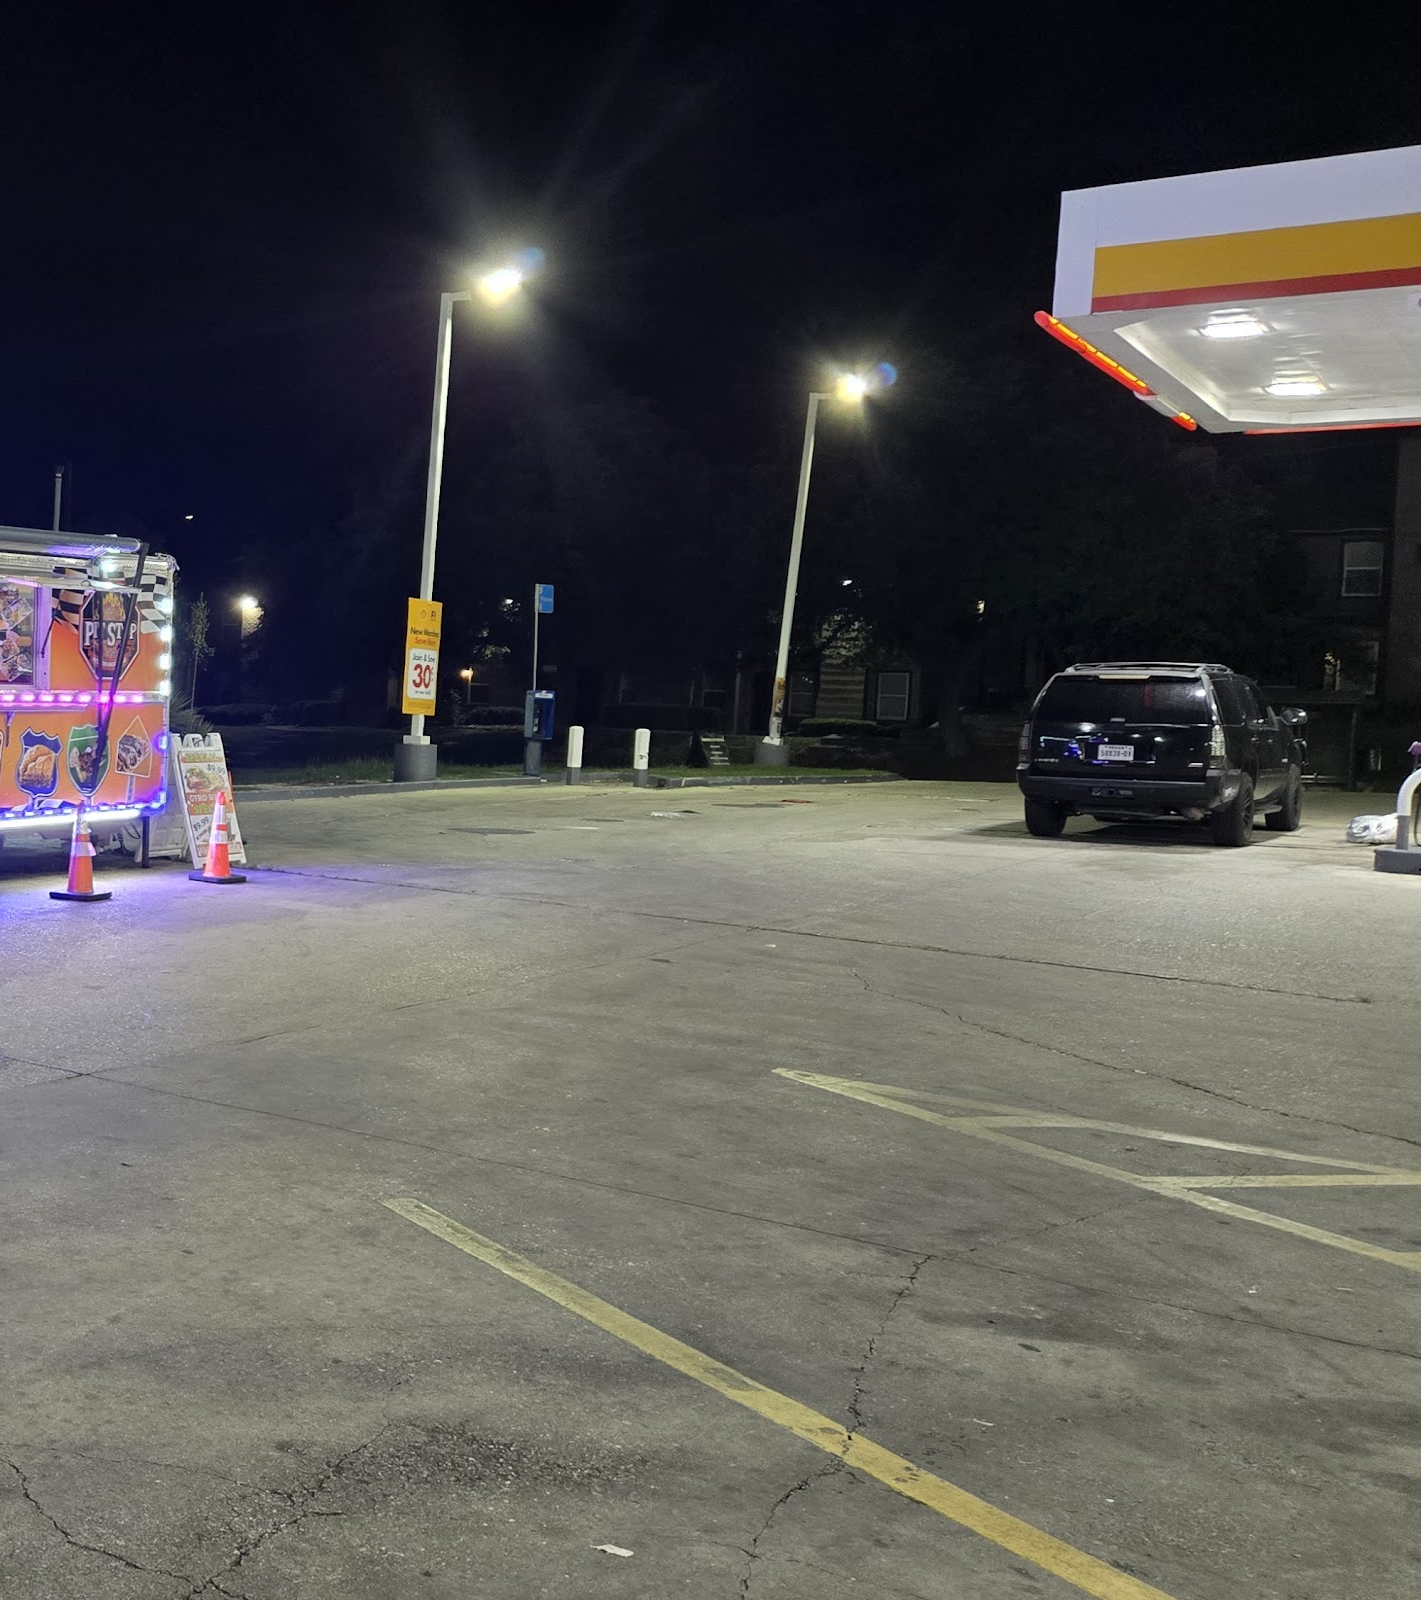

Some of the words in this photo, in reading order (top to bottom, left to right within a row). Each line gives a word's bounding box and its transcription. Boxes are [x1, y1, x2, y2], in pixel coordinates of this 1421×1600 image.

[107, 621, 137, 646] STP
[410, 627, 423, 635] New
[207, 764, 226, 775] $9.99
[189, 794, 208, 803] GYRO
[193, 816, 210, 832] $9.99
